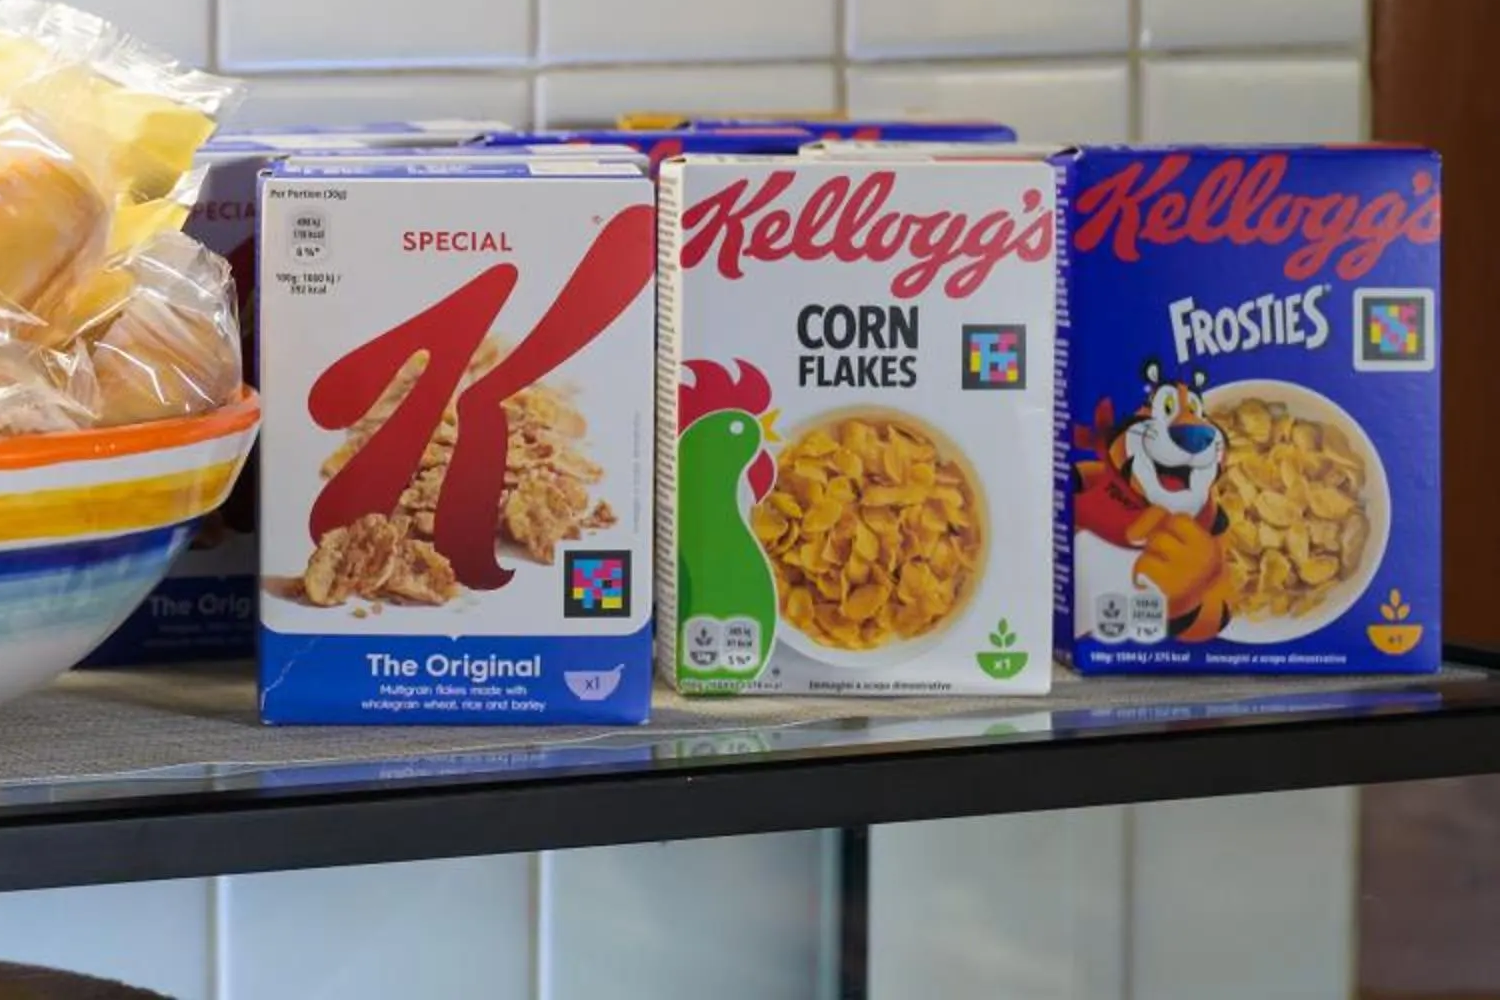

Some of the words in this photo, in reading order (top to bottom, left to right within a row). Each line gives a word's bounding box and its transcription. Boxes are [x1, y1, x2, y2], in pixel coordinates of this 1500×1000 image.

[191, 201, 256, 221] PECIA
[1074, 154, 1441, 281] Kellogg's
[402, 231, 513, 252] SPECIAL
[680, 170, 1055, 299] Kellogg's
[797, 303, 919, 350] CORN
[1169, 285, 1330, 364] FROSTIES
[799, 355, 917, 388] FLAKES
[198, 591, 252, 619] Orig
[366, 653, 419, 677] The
[425, 653, 542, 683] Original
